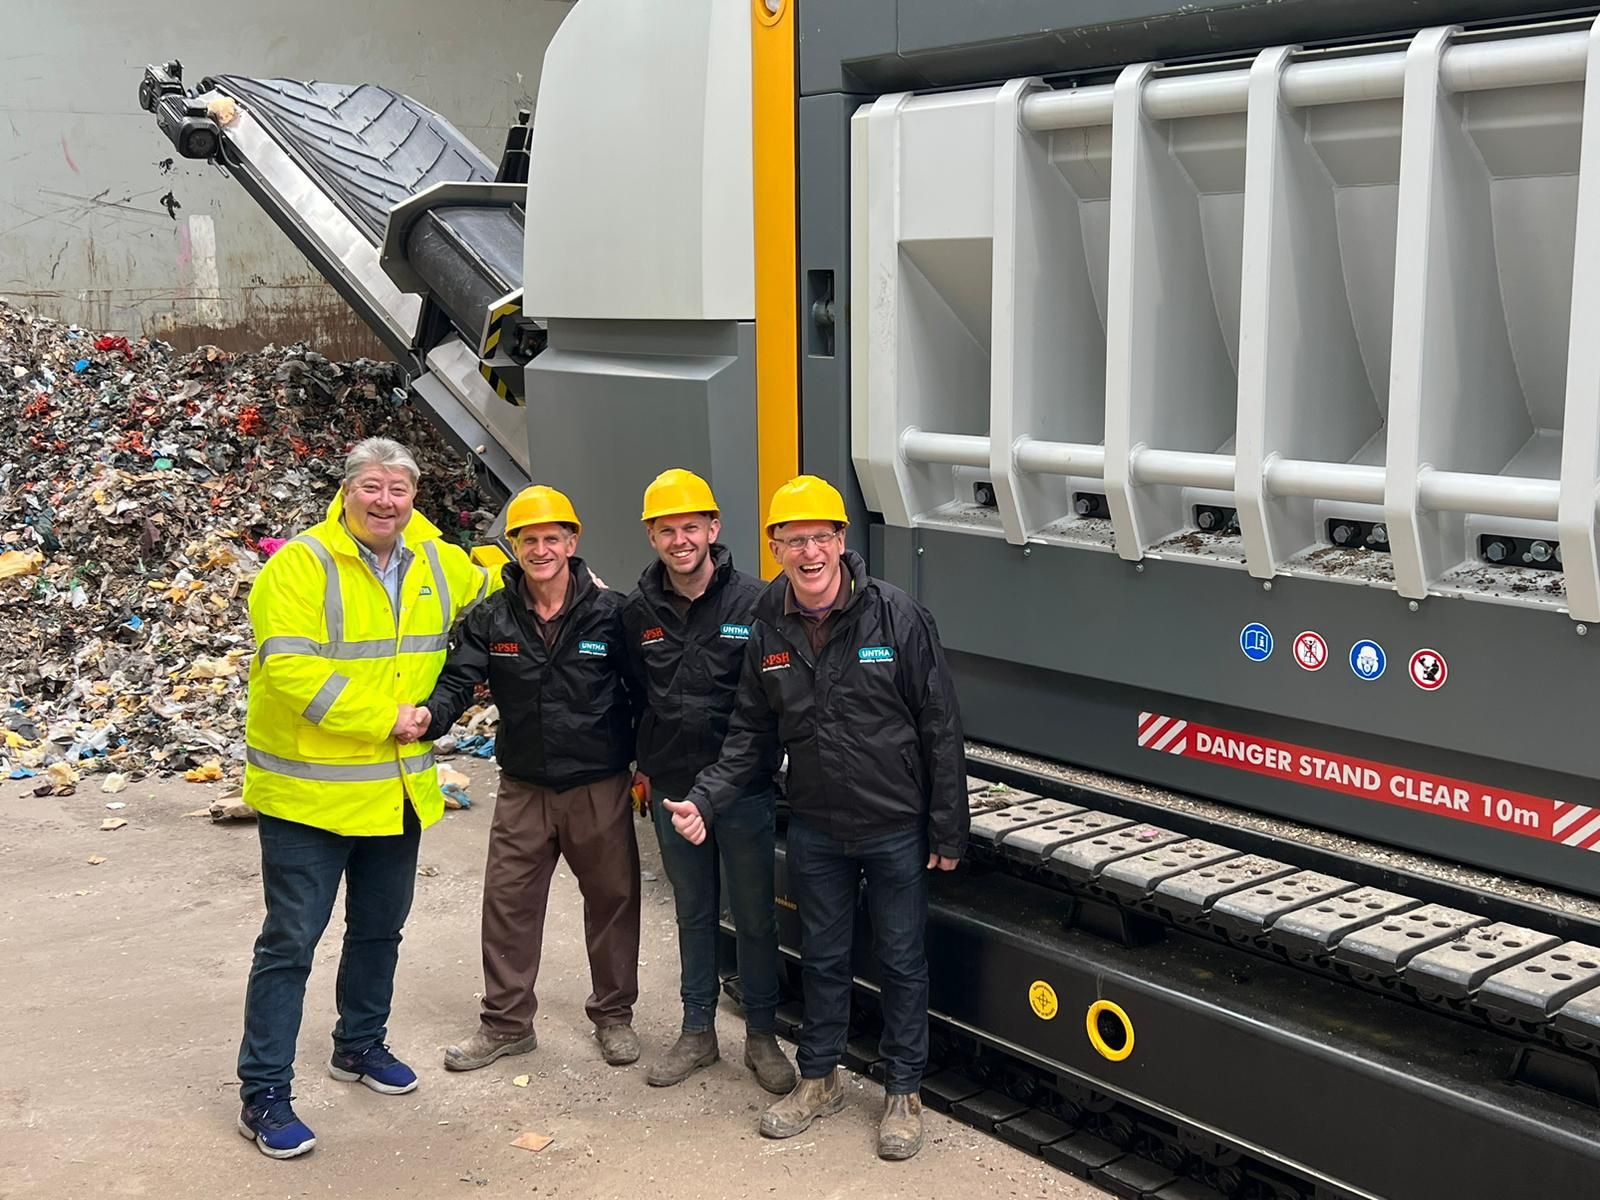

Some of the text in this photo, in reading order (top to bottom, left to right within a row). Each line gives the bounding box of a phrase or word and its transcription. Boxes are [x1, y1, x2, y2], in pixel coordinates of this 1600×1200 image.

[646, 628, 664, 639] PSH
[722, 625, 749, 635] UNTHA
[498, 643, 519, 652] PSH
[582, 643, 605, 651] UNTHA
[768, 651, 790, 665] PSH
[862, 648, 890, 658] UNTHA
[1197, 732, 1540, 828] DANGER STAND CLEAR 10m
